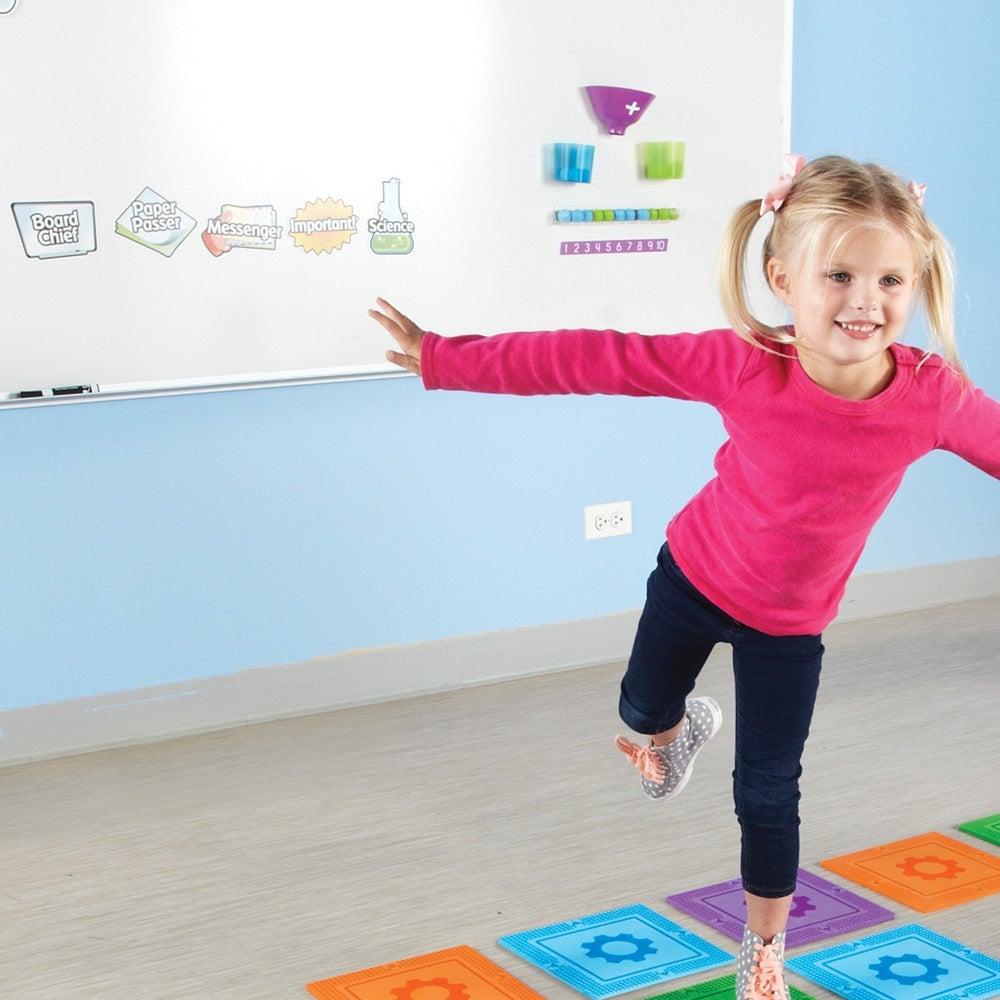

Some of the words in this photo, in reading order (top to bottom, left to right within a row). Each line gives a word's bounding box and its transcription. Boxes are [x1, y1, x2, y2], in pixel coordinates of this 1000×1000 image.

[132, 201, 177, 219] Paper
[31, 210, 79, 231] Board
[131, 215, 181, 233] Passer
[207, 218, 283, 240] Messenger
[368, 218, 415, 233] Science
[38, 227, 79, 245] Chief
[574, 243, 580, 253] 2
[585, 243, 590, 253] 3
[595, 242, 600, 252] 4
[606, 242, 611, 252] 5
[616, 242, 622, 251] 6
[627, 241, 632, 251] 7
[637, 241, 643, 251] 8
[648, 241, 653, 250] 9
[657, 240, 665, 250] 10
